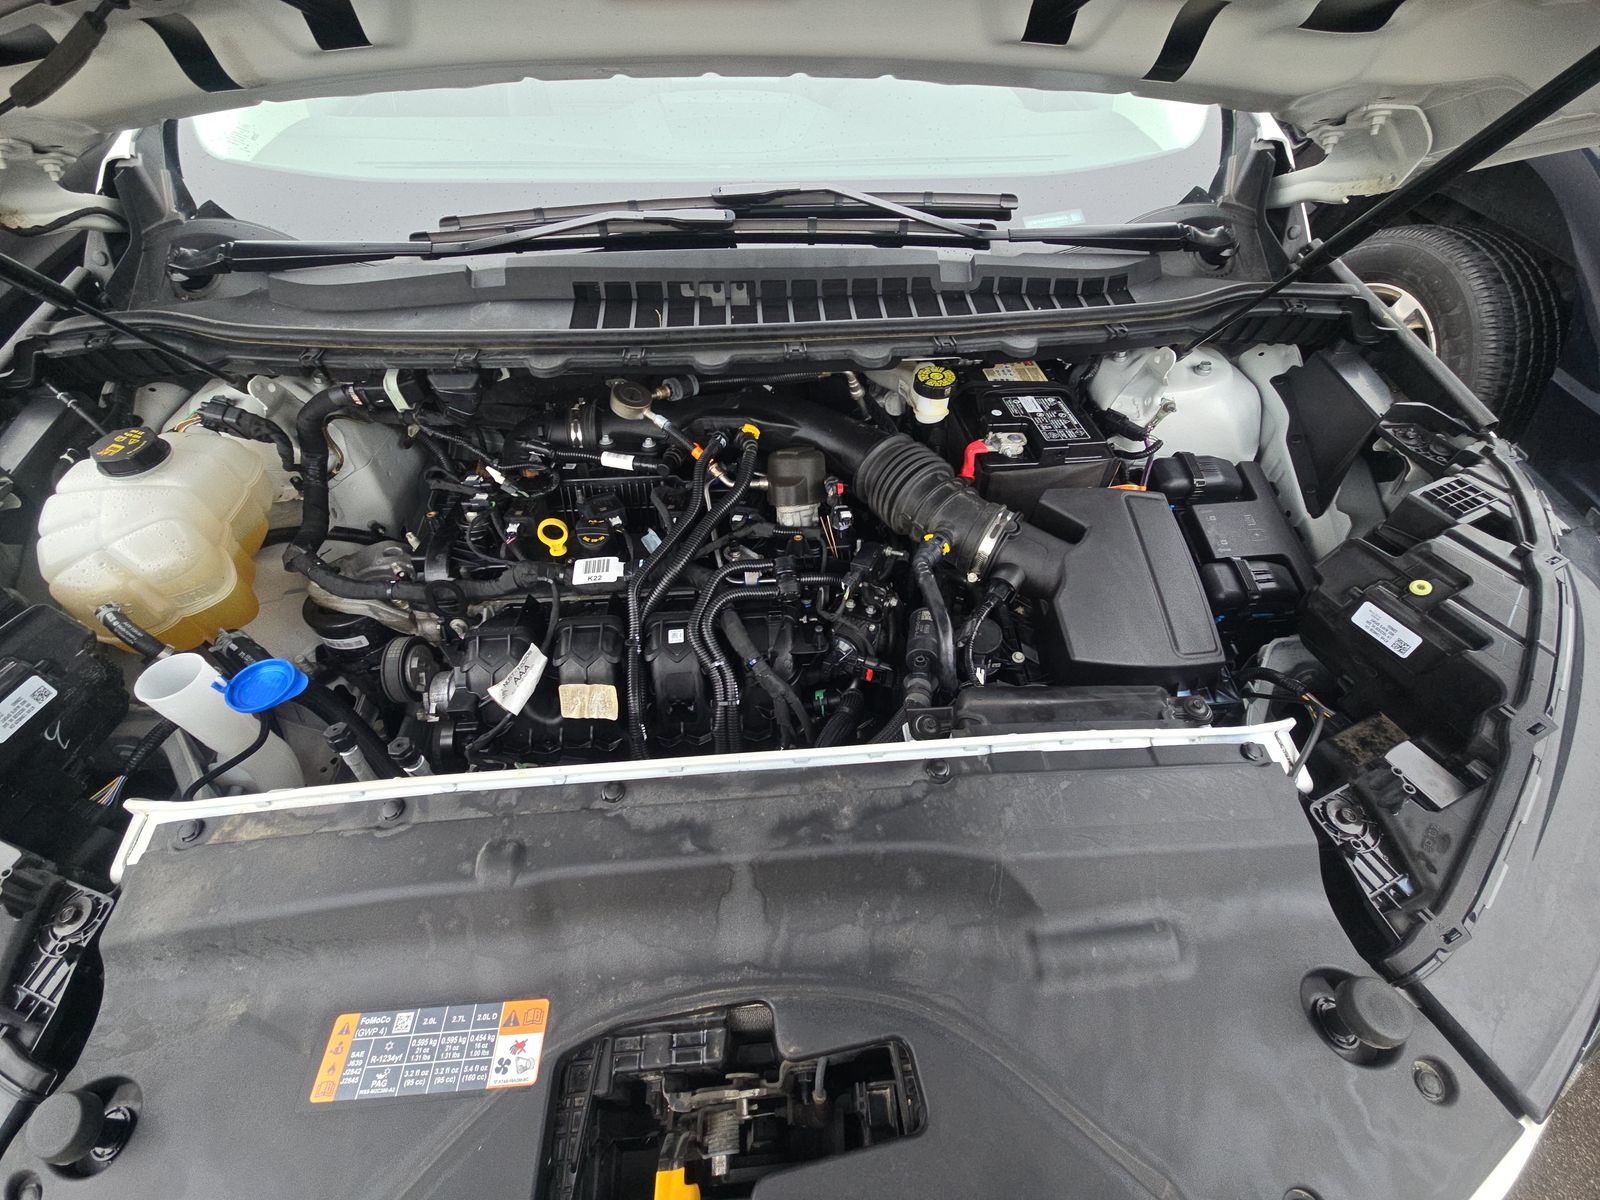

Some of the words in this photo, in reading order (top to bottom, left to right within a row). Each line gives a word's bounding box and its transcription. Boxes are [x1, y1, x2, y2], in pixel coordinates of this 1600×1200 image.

[361, 1016, 391, 1025] FoMoCo
[355, 1028, 378, 1038] (GWP
[379, 1027, 388, 1037] 4)
[412, 1038, 428, 1047] 0.595
[428, 1038, 438, 1047] kg
[441, 1036, 458, 1045] 0.595
[458, 1036, 467, 1045] kg
[470, 1034, 486, 1042] 0.454
[487, 1034, 496, 1043] kg
[350, 1050, 365, 1058] SAE
[370, 1054, 402, 1064] R-1234yf
[434, 1067, 444, 1075] 3.2
[464, 1065, 473, 1073] 5.4
[434, 1076, 444, 1085] (95
[446, 1075, 456, 1084] cc)
[476, 1073, 488, 1081] cc)
[370, 1079, 388, 1088] PAG
[404, 1079, 414, 1088] (95
[415, 1078, 426, 1087] cc)
